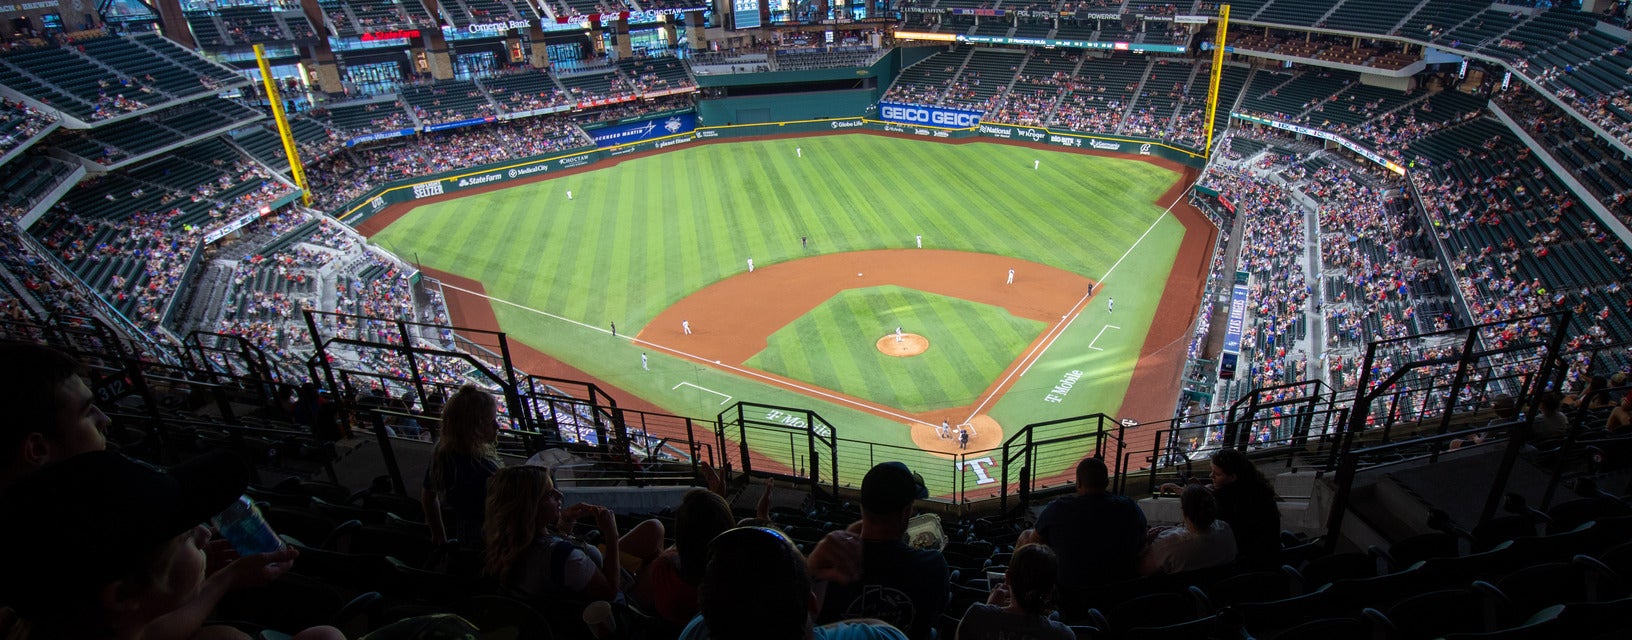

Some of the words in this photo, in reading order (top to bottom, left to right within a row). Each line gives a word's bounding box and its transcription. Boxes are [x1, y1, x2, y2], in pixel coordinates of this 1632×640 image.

[647, 8, 682, 17] CHOCTAW
[509, 19, 531, 29] Bank
[882, 106, 930, 123] GEICO
[932, 110, 981, 127] GEICO
[622, 129, 643, 137] MARTIN
[986, 126, 1012, 135] National
[1025, 128, 1045, 141] Kroger
[660, 140, 675, 148] planet
[517, 166, 538, 176] Medical
[537, 164, 548, 172] City
[414, 184, 444, 199] SELTZER
[1230, 298, 1245, 319] RANGERS
[1228, 318, 1242, 335] TEXAS
[1051, 369, 1083, 396] Mobile
[97, 380, 126, 402] 312
[955, 456, 999, 485] T
